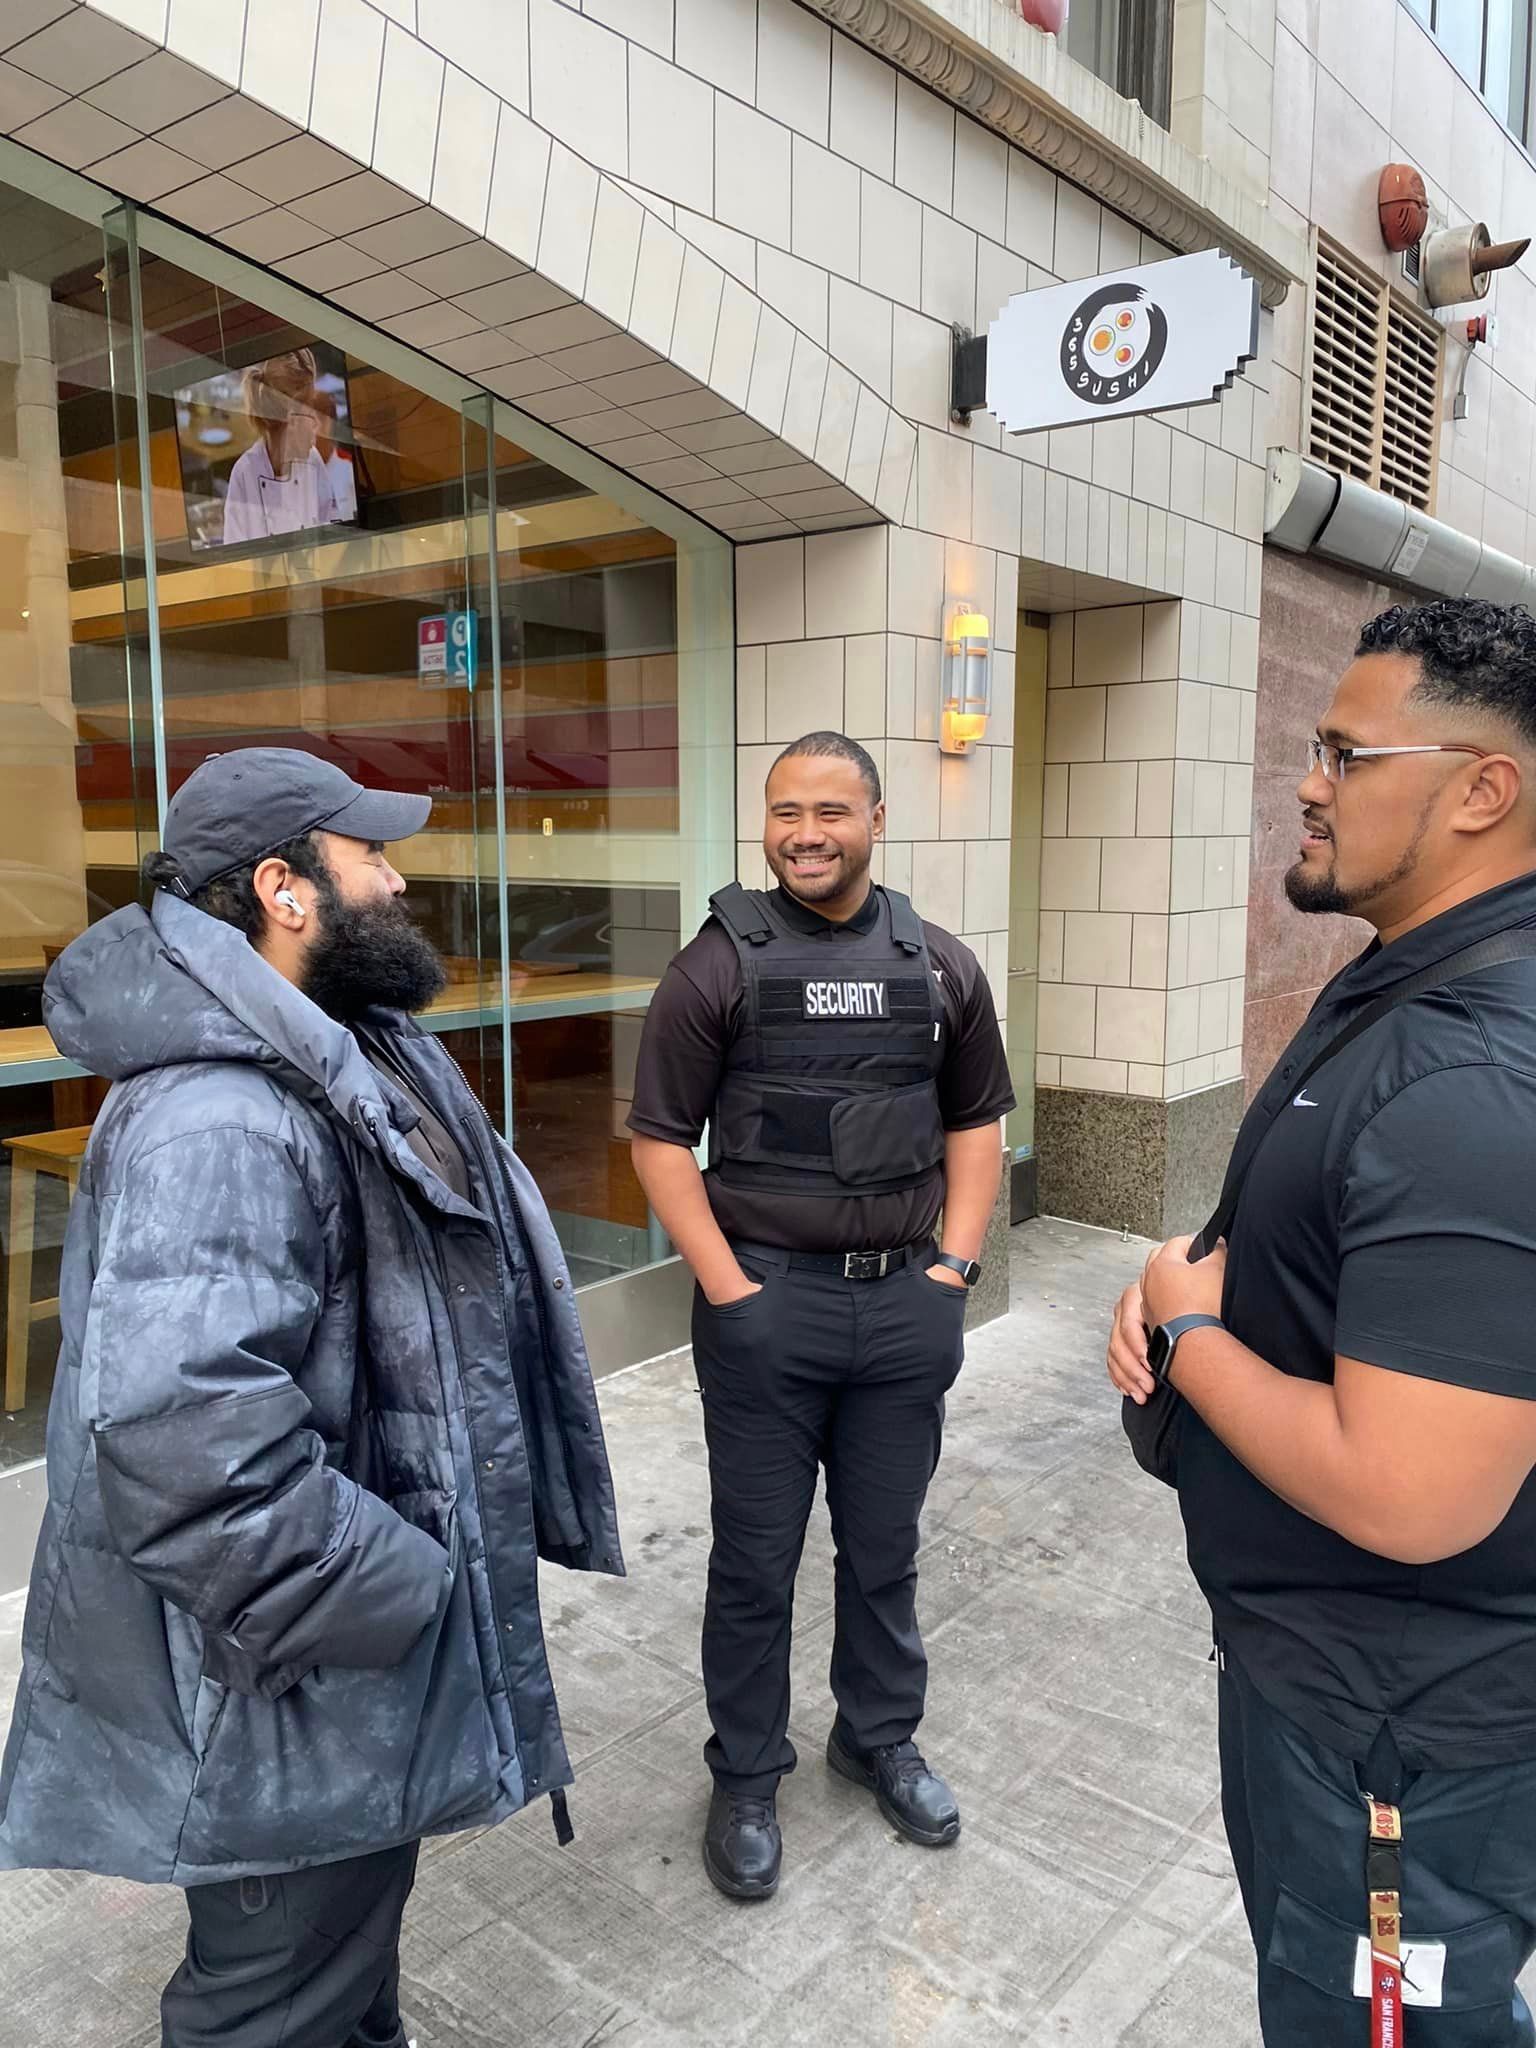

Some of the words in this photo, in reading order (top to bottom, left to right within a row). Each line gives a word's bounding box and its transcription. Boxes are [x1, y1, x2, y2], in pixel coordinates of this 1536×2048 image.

[1067, 316, 1084, 371] 365
[1076, 360, 1150, 398] SUSHI
[806, 982, 884, 1015] SECURITY
[1382, 1998, 1393, 2016] SAN
